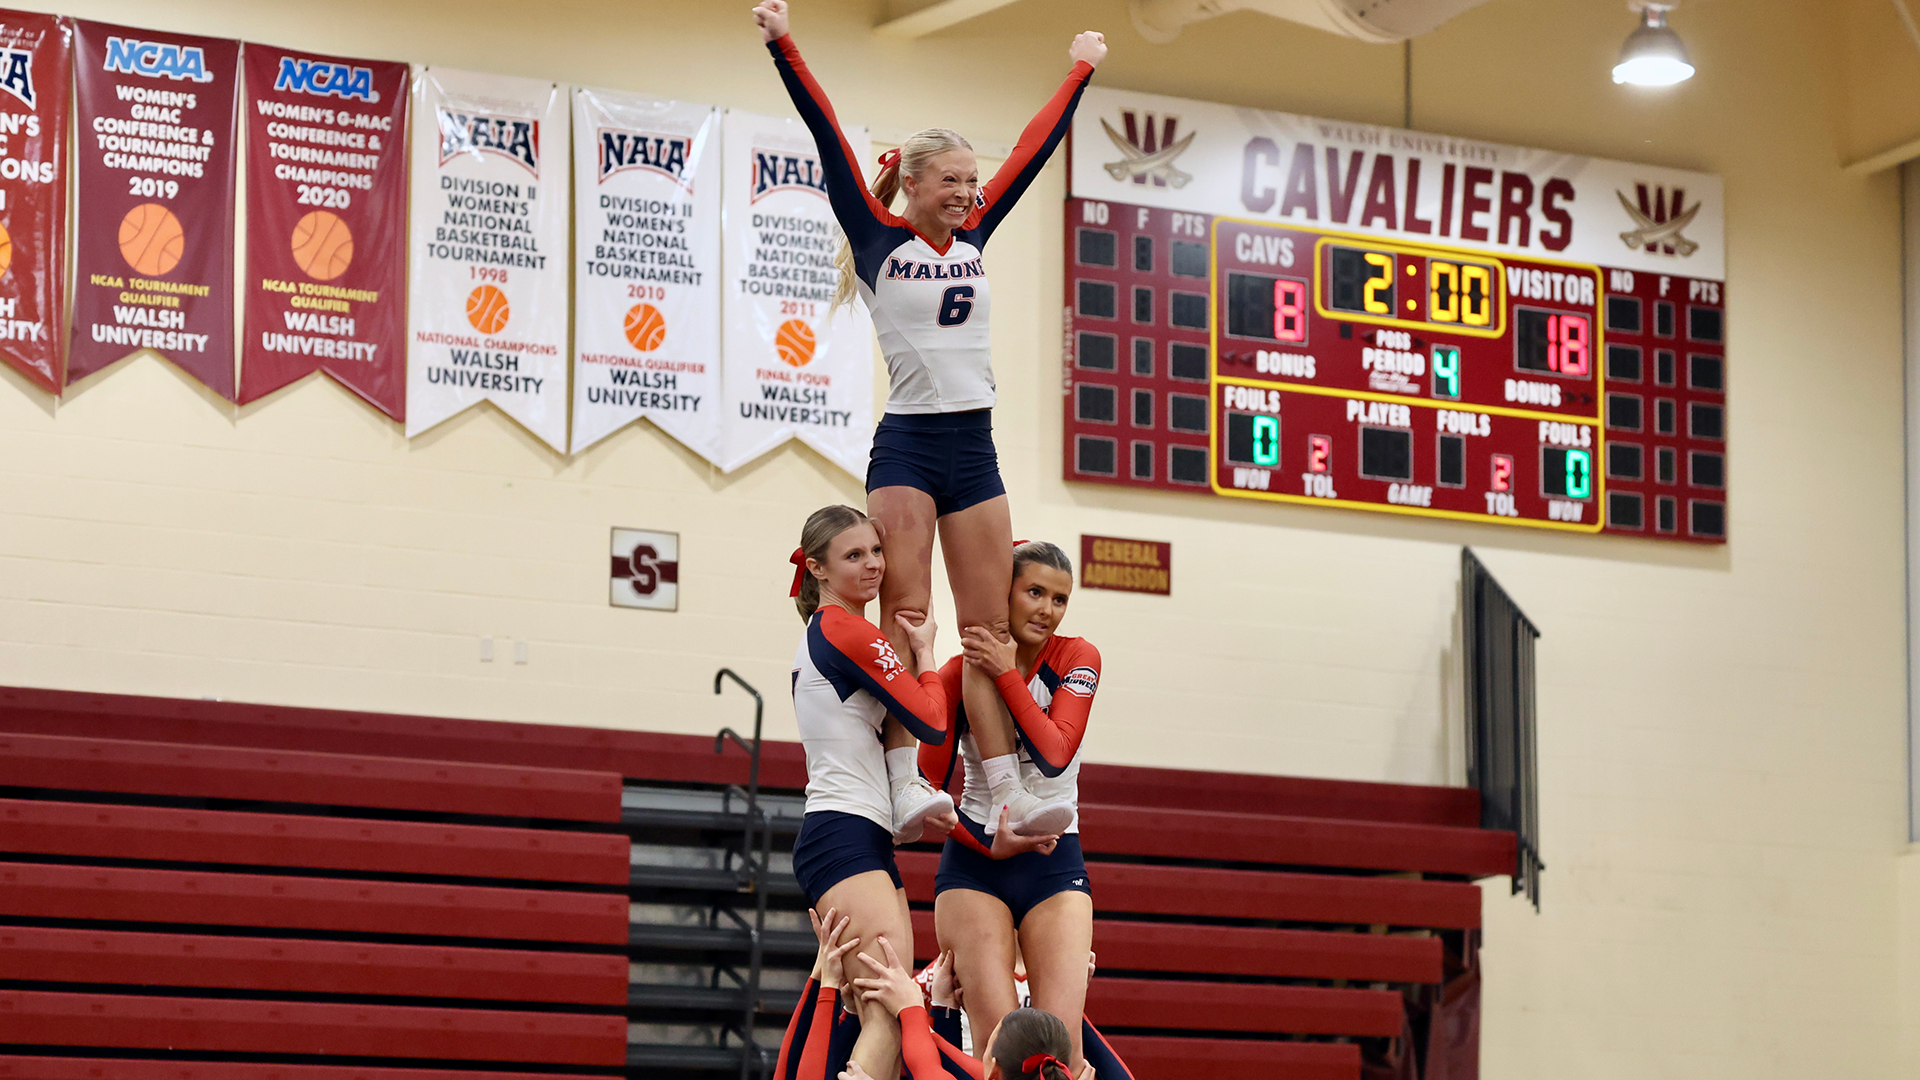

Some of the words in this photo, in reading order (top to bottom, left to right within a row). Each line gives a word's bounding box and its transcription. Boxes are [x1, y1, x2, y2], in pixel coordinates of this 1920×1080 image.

[104, 37, 206, 82] NCAA
[274, 56, 371, 102] NCAA
[116, 85, 197, 109] WOMEN'S
[131, 104, 181, 124] GMAC
[257, 100, 335, 124] WOMEN'S
[337, 111, 392, 132] G-MAC
[93, 117, 198, 143] CONFERENCE
[202, 130, 214, 146] &
[267, 122, 366, 149] CONFERENCE
[368, 135, 381, 150] &
[1320, 125, 1380, 145] WALSH
[1389, 134, 1498, 163] UNIVERSITY
[97, 134, 211, 162] TOURNAMENT
[268, 142, 379, 170] TOURNAMENT
[602, 132, 688, 181] NAIA
[103, 152, 203, 178] CHAMPIONS
[275, 164, 372, 190] CHAMPIONS
[129, 176, 179, 200] 2019
[297, 185, 351, 209] 2020
[441, 176, 519, 198] DIVISION
[1240, 136, 1575, 251] CAVALIERS
[448, 194, 529, 216] WOMEN'S
[600, 195, 675, 216] DIVISION
[682, 204, 692, 217] II
[1083, 201, 1109, 225] NO
[444, 211, 532, 234] NATIONAL
[607, 212, 685, 233] WOMEN'S
[752, 214, 828, 235] DIVISION
[1137, 208, 1149, 229] F
[1172, 213, 1205, 237] PTS
[436, 227, 538, 252] BASKETBALL
[603, 229, 688, 251] NATIONAL
[760, 231, 835, 253] WOMEN'S
[1236, 232, 1295, 268] CAVS
[427, 243, 546, 270] TOURNAMENT
[595, 245, 695, 268] BASKETBALL
[91, 274, 124, 289] NCAA
[129, 278, 209, 297] TOURNAMENT
[469, 266, 508, 283] 1998
[586, 261, 703, 286] TOURNAMENT
[749, 264, 840, 286] BASKETBAL
[1506, 266, 1595, 306] VISITOR
[1611, 270, 1634, 294] NO
[262, 278, 297, 293] NCAA
[299, 282, 378, 303] TOURNAMENT
[627, 284, 666, 301] 2010
[1363, 252, 1490, 326] 2:00
[1659, 276, 1670, 297] F
[1689, 280, 1720, 304] PTS
[119, 292, 180, 309] QUALIFIER
[290, 295, 350, 313] QUALIFIER
[780, 300, 815, 317] 2011
[936, 284, 976, 328] 6
[1274, 279, 1305, 342] 8
[113, 305, 185, 330] WALSH
[284, 311, 355, 337] WALSH
[92, 324, 209, 353] UNIVERSITY
[262, 332, 377, 362] UNIVERSITY
[416, 331, 479, 347] NATIONAL
[484, 338, 558, 356] CHAMPIONS
[1376, 329, 1412, 351] POSS
[1547, 314, 1588, 375] 18
[450, 349, 519, 371] WALSH
[581, 352, 642, 368] NATIONAL
[645, 358, 706, 374] QUALIFIER
[1256, 350, 1316, 379] BONUS
[1362, 347, 1426, 376] PERIOD
[1433, 349, 1459, 396] 4
[427, 367, 544, 394] UNIVERSITY
[610, 369, 677, 390] WALSH
[756, 368, 792, 383] FINAL
[796, 372, 831, 387] FOUR
[588, 387, 701, 412] UNIVERSITY
[761, 385, 826, 405] WALSH
[1224, 385, 1281, 414] FOULS
[1504, 378, 1562, 407] BONUS
[740, 402, 851, 427] UNIVERSITY
[1346, 399, 1411, 428] PLAYER
[1436, 409, 1491, 437] FOULS
[1253, 415, 1279, 465] 0
[1538, 420, 1592, 448] FOULS
[1311, 437, 1329, 472] 2
[1233, 467, 1271, 490] WON
[1302, 473, 1337, 499] TOL
[1493, 456, 1512, 491] 2
[1565, 449, 1590, 499] 0
[1387, 482, 1433, 507] GAME
[1484, 491, 1519, 517] TOL
[1548, 500, 1584, 522] WON
[1092, 540, 1161, 567] GENERAL
[631, 544, 659, 597] S
[1084, 562, 1168, 591] ADMISSION
[1071, 673, 1095, 683] GREAT
